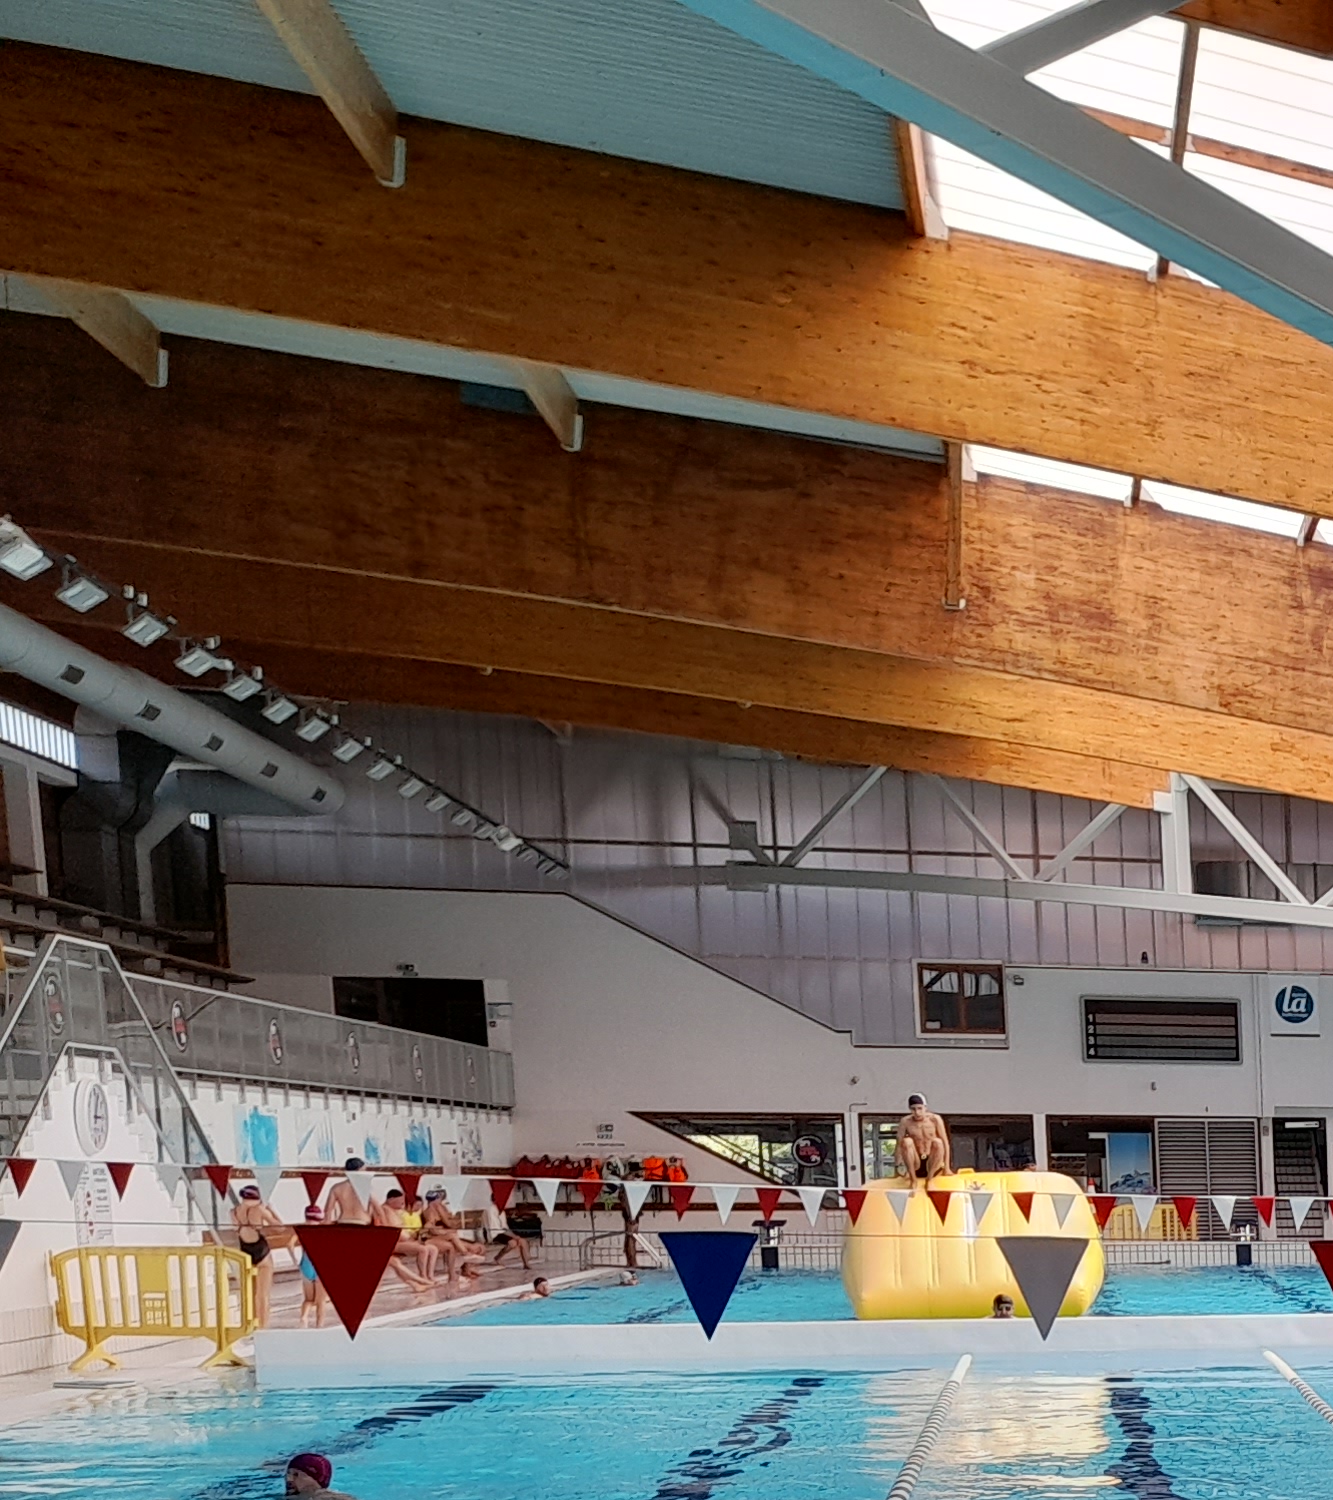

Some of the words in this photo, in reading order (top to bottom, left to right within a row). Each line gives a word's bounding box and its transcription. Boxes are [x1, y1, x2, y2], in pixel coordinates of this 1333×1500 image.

[1087, 1013, 1094, 1023] 1
[1087, 1025, 1095, 1034] 2
[1088, 1036, 1095, 1045] 3
[1088, 1047, 1095, 1056] 4
